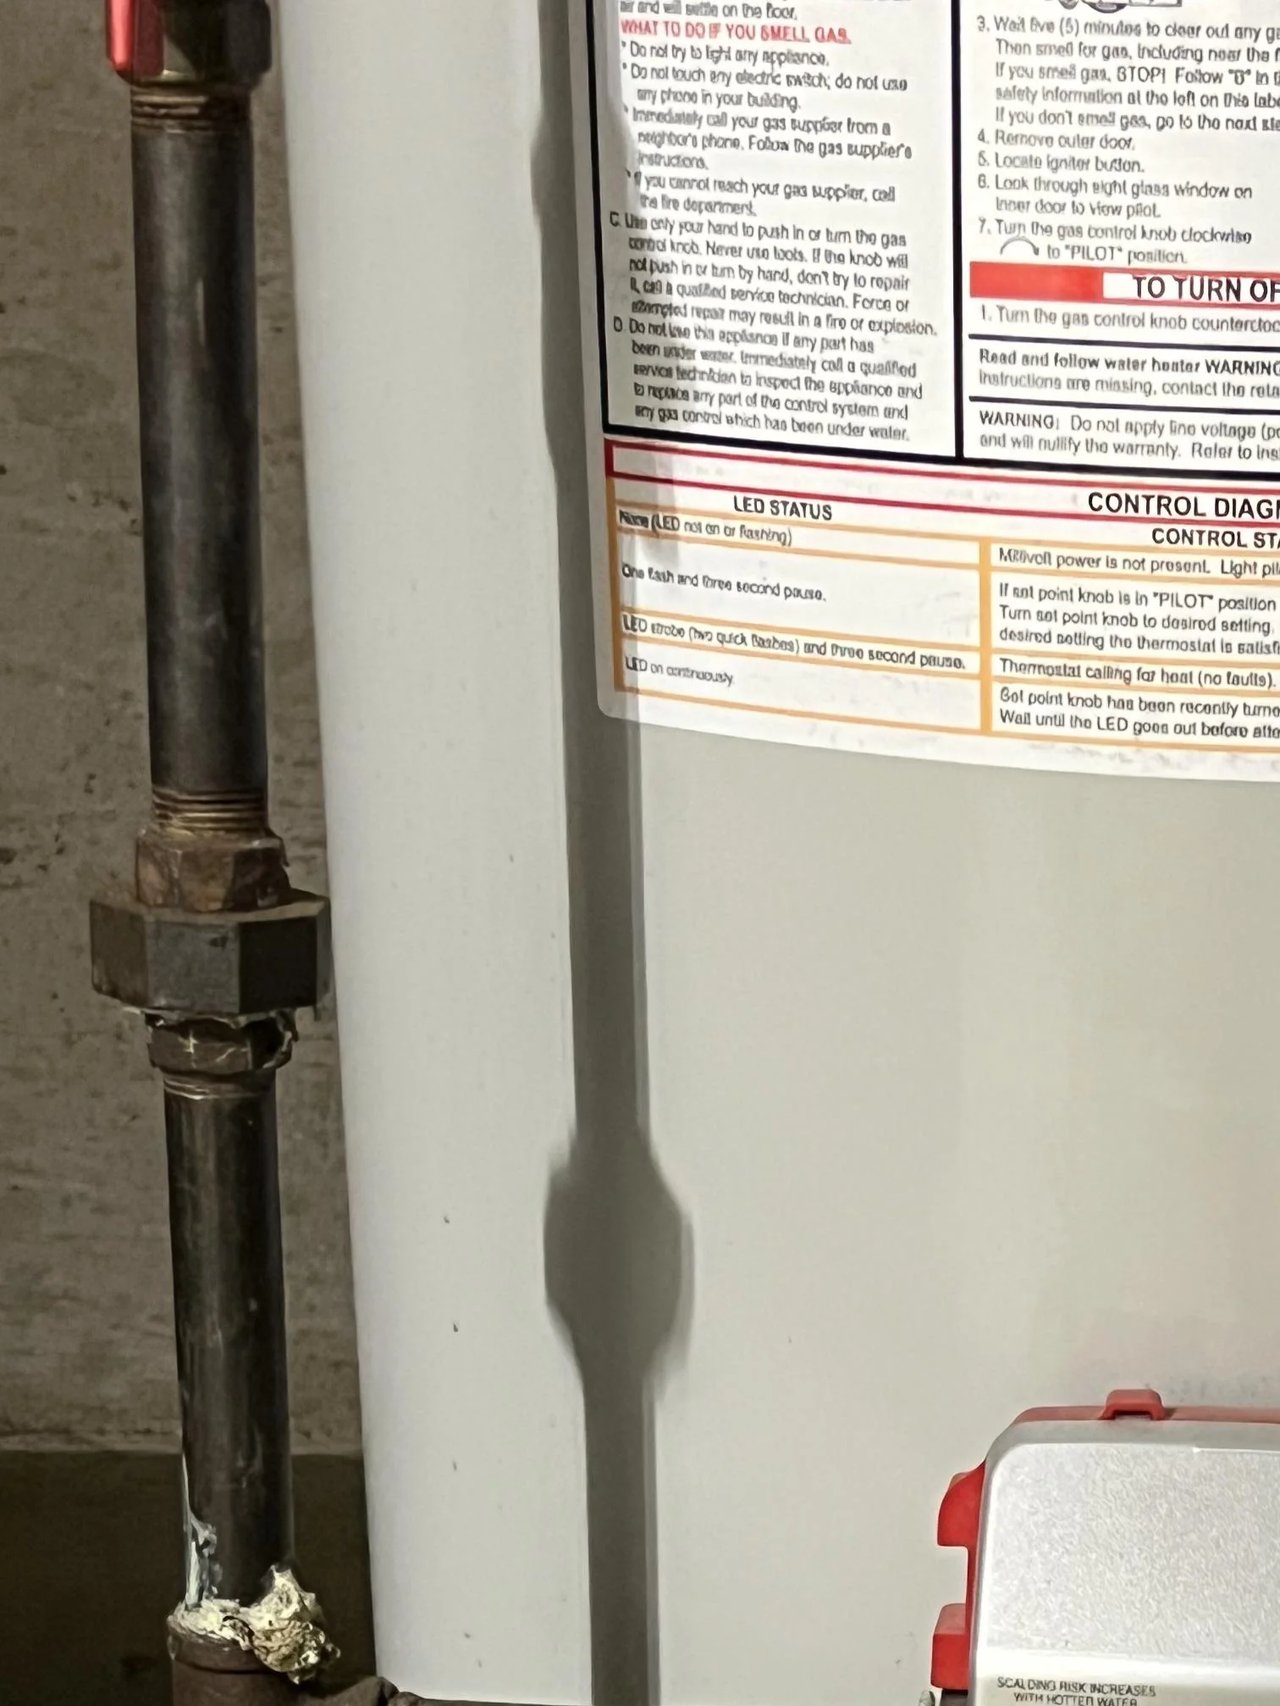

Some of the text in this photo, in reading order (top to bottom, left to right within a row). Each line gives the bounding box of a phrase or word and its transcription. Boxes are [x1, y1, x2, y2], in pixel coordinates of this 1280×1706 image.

[620, 18, 658, 37] WHAT
[663, 20, 680, 36] TO
[685, 21, 705, 38] DO
[725, 23, 755, 40] YOU
[760, 25, 809, 42] SMELL
[977, 15, 989, 31] 3.
[994, 15, 1025, 32] Wait
[1030, 16, 1054, 33] five
[1059, 17, 1079, 37] (5)
[1084, 20, 1141, 36] minutes
[1146, 21, 1160, 36] to
[1165, 22, 1201, 38] clear
[1205, 23, 1228, 38] out
[1234, 26, 1261, 42] any
[630, 41, 646, 57] Do
[650, 44, 667, 57] not
[671, 44, 686, 62] try
[690, 45, 702, 59] to
[735, 49, 758, 66] any
[996, 61, 1005, 76] If
[1008, 65, 1033, 80] you
[1080, 67, 1111, 83] gas,
[1175, 66, 1223, 83] Follow
[1255, 70, 1268, 85] in
[977, 128, 988, 143] 4.
[995, 129, 1053, 147] Remove
[1058, 133, 1095, 148] outer
[978, 151, 989, 166] 5.
[995, 152, 1042, 169] Locate
[1047, 244, 1060, 258] to
[1065, 244, 1122, 260] "PILOT"
[1132, 275, 1165, 298] TO
[1173, 275, 1240, 301] TURN
[996, 304, 1029, 322] Turn
[1034, 308, 1056, 324] the
[1062, 312, 1089, 327] gas
[1093, 312, 1144, 327] control
[1150, 313, 1186, 329] knob
[979, 348, 1016, 364] Read
[1021, 352, 1048, 366] and
[1054, 352, 1099, 369] follow
[1104, 357, 1146, 371] water
[1152, 357, 1199, 372] heater
[733, 495, 832, 520] LED STATUS
[1088, 492, 1205, 516] CONTROL
[1152, 528, 1247, 547] CONTROL
[623, 614, 647, 633] LED
[804, 642, 826, 655] and
[625, 656, 648, 671] LED
[999, 657, 1081, 677] Thermostat
[1085, 665, 1131, 684] calling
[1137, 666, 1155, 682] for
[1161, 668, 1192, 683] heat
[1198, 670, 1221, 687] (no
[1000, 708, 1030, 725] Wait
[1035, 713, 1064, 726] until
[1070, 715, 1091, 728] the
[1097, 716, 1128, 731] LED
[1133, 721, 1168, 734] goes
[1173, 722, 1196, 735] out
[1201, 721, 1248, 737] before
[997, 1677, 1155, 1697] SCALDING RISK INCREASES
[1013, 1692, 1043, 1702] WITH
[1046, 1694, 1093, 1706] HOTTER
